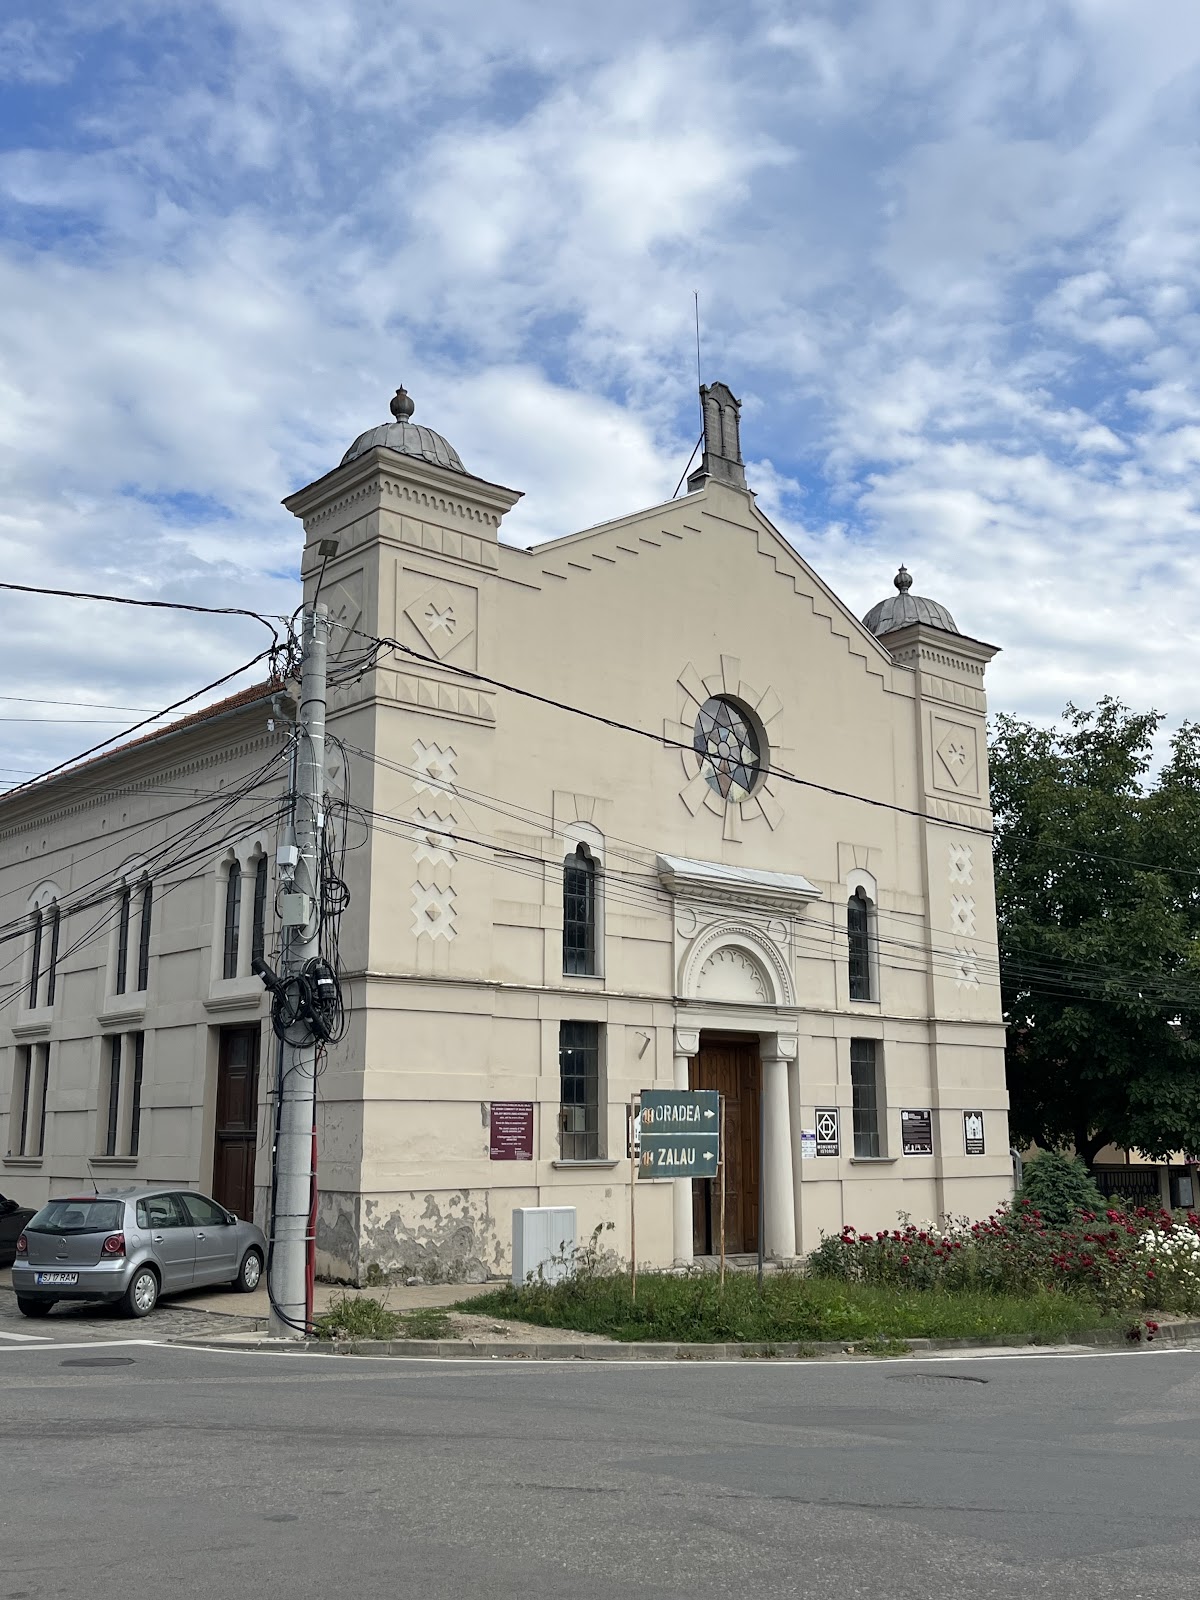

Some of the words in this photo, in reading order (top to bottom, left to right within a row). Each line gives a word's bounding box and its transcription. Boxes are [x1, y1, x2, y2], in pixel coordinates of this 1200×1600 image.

[655, 1104, 701, 1122] ORADEA
[657, 1147, 696, 1166] ZALAU
[42, 1273, 52, 1282] SJ
